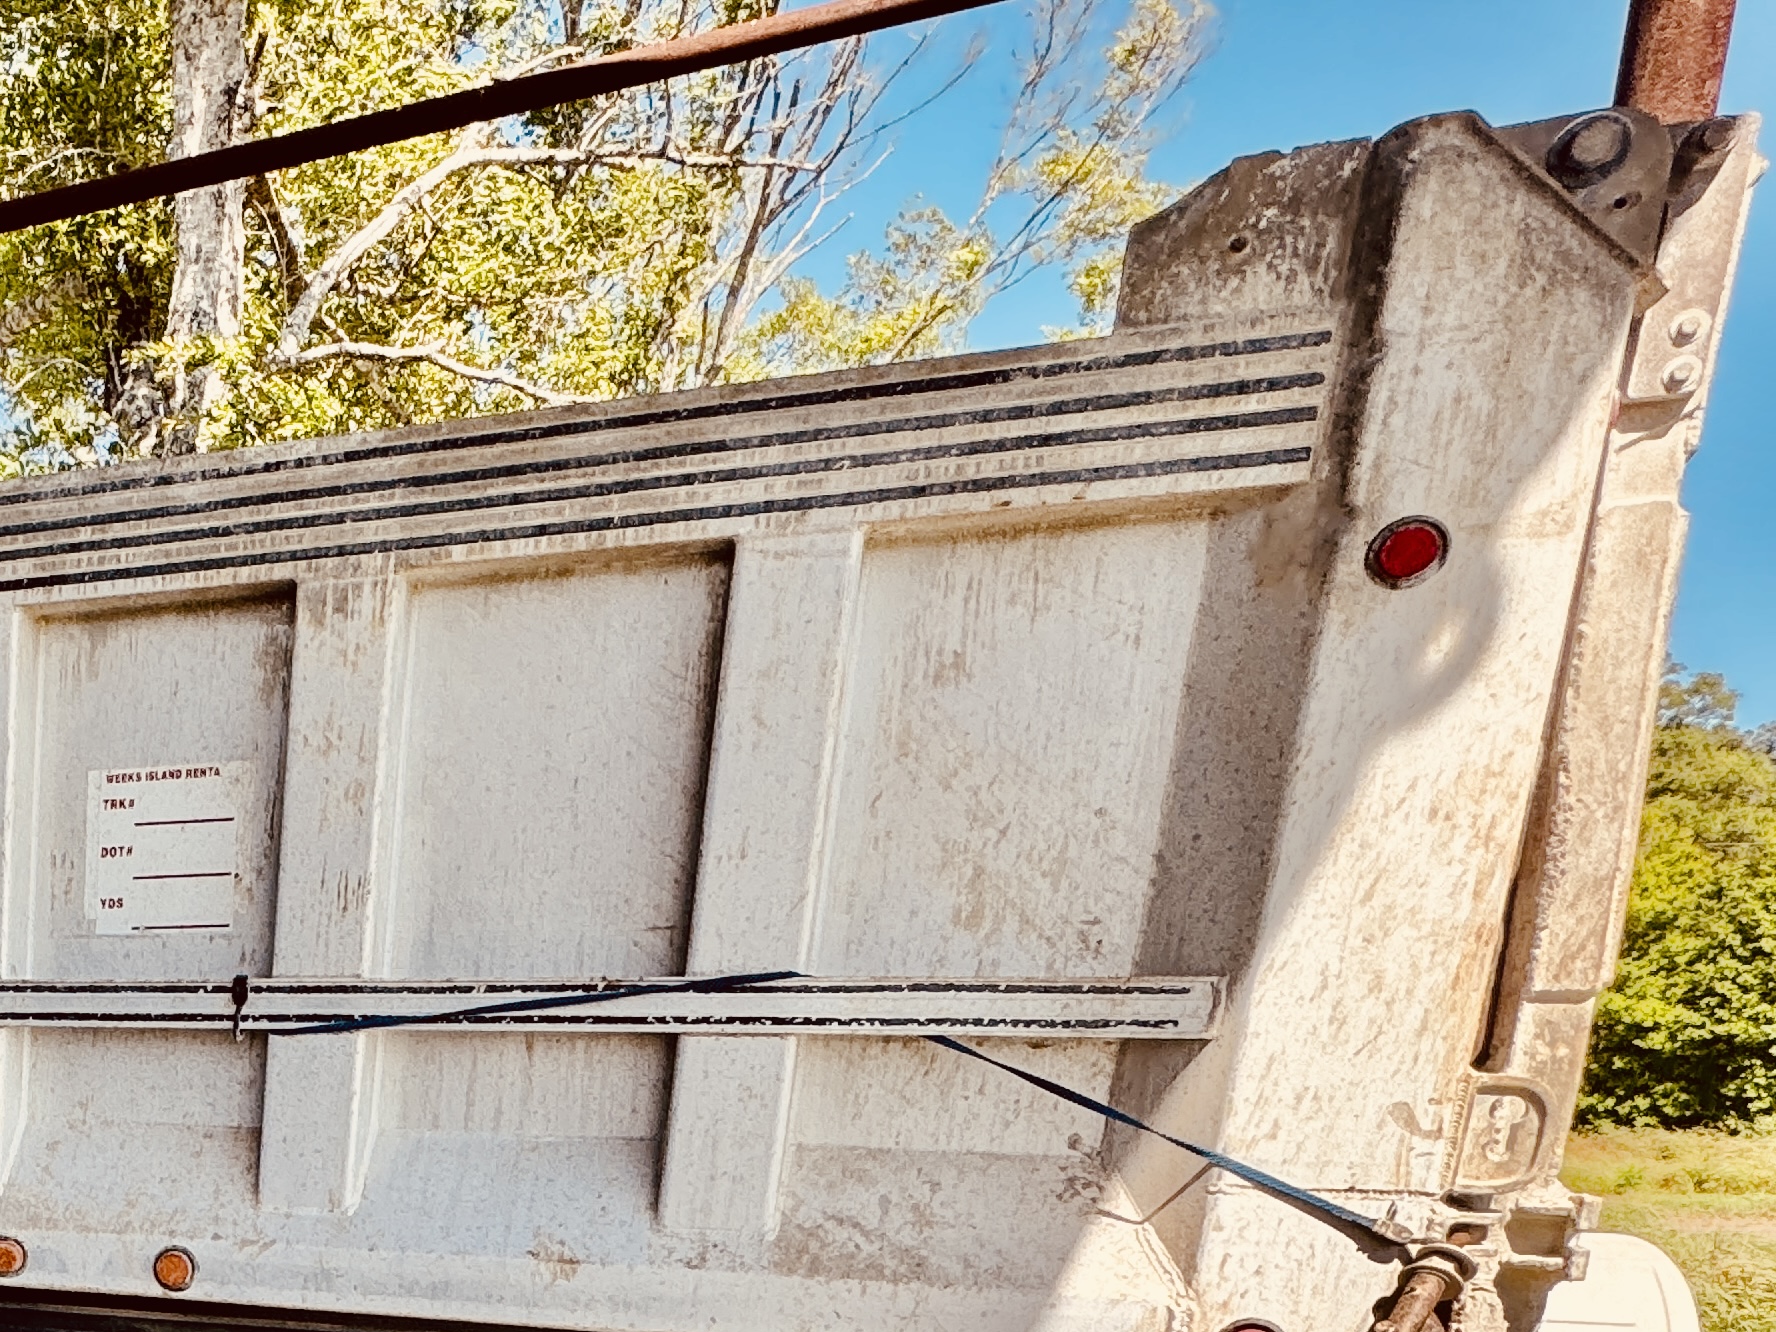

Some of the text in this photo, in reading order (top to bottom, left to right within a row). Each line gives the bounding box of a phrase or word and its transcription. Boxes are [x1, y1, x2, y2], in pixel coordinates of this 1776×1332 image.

[106, 772, 142, 784] WEEKS
[145, 769, 182, 781] ISLAND
[101, 845, 133, 859] DOT#
[100, 897, 124, 909] YDS
